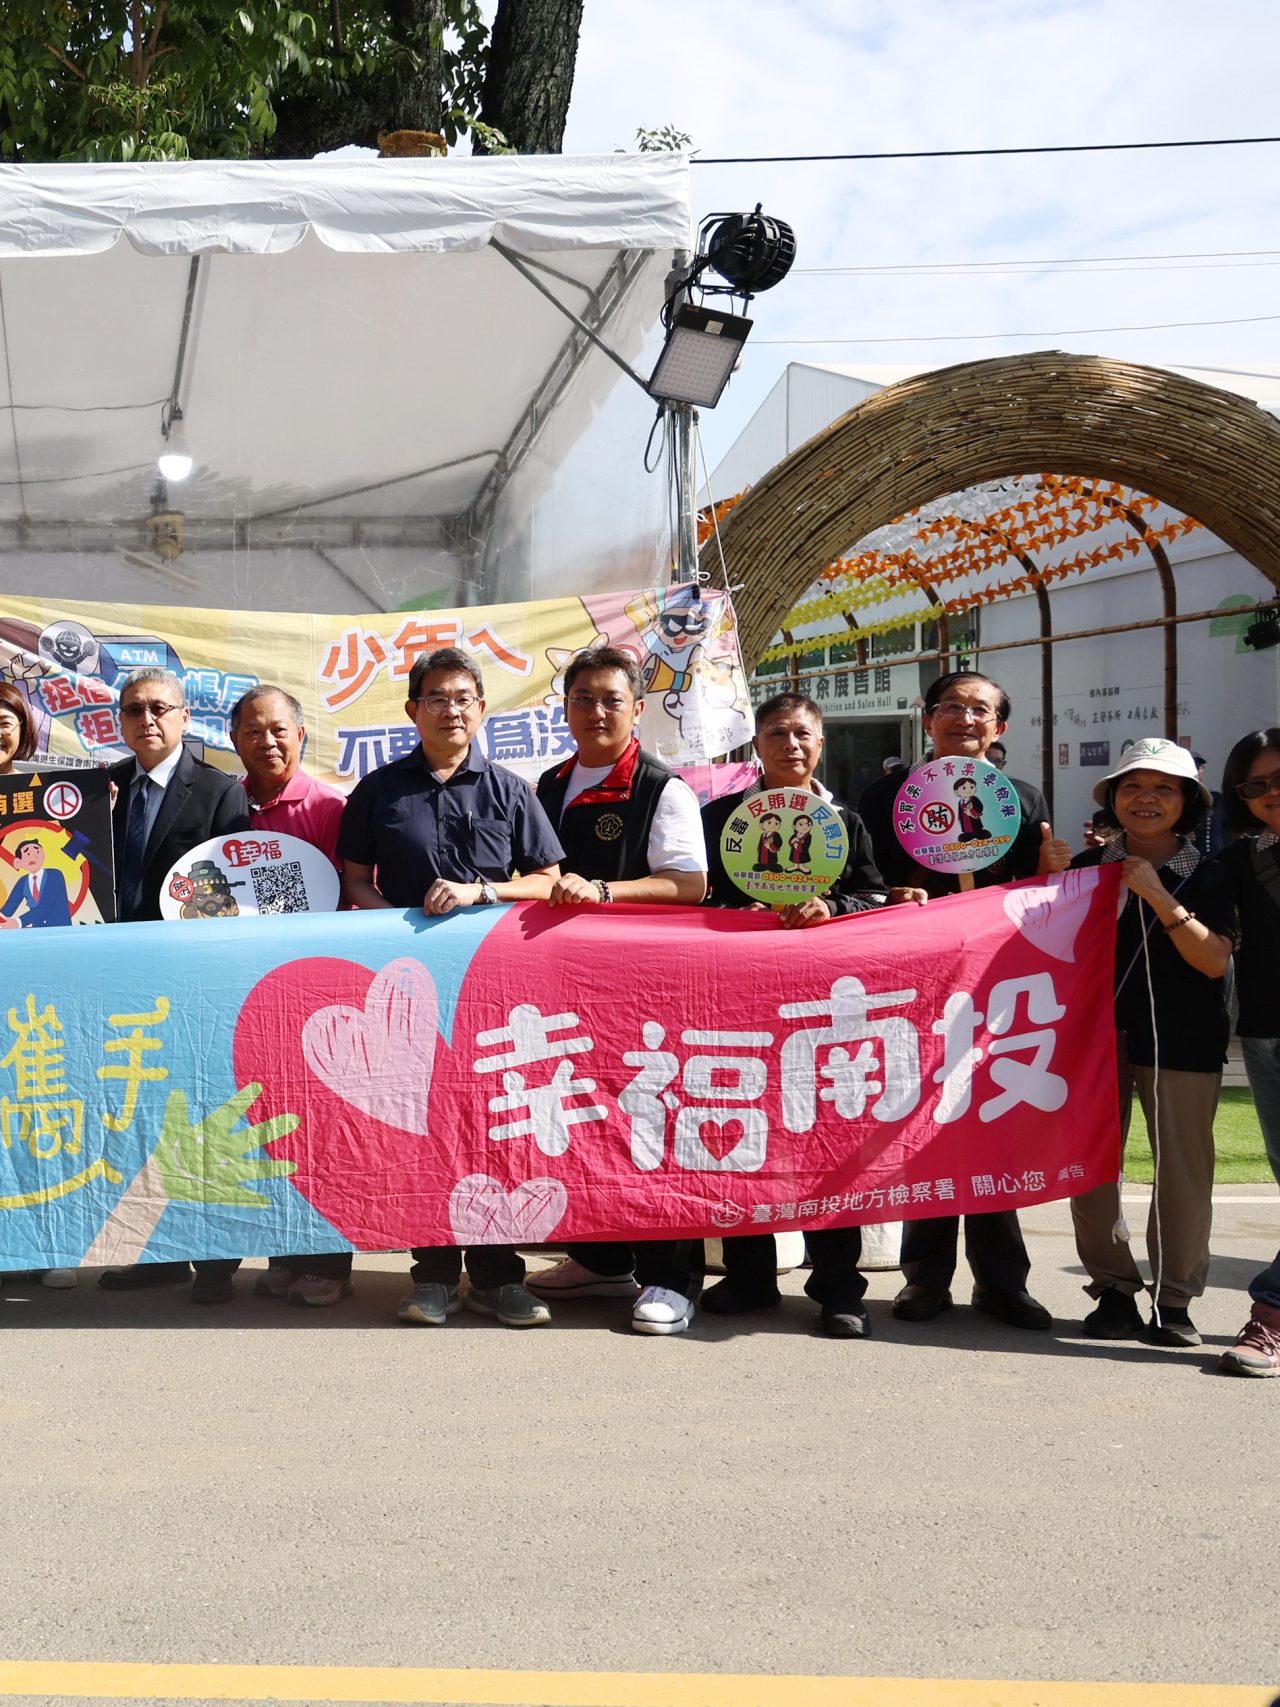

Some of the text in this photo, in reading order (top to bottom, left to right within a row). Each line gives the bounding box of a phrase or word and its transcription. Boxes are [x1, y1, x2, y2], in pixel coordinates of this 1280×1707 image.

[120, 649, 159, 663] ATM
[747, 793, 809, 819] 反賄選
[725, 816, 750, 853] 反毒
[810, 805, 844, 860] 反暴力
[942, 835, 1012, 852] 0800-024-099
[762, 873, 832, 884] 0800-024-099
[473, 970, 1069, 1173] 幸福南投
[750, 1178, 957, 1225] 臺灣南投地方檢察署
[971, 1169, 1047, 1198] 關心您
